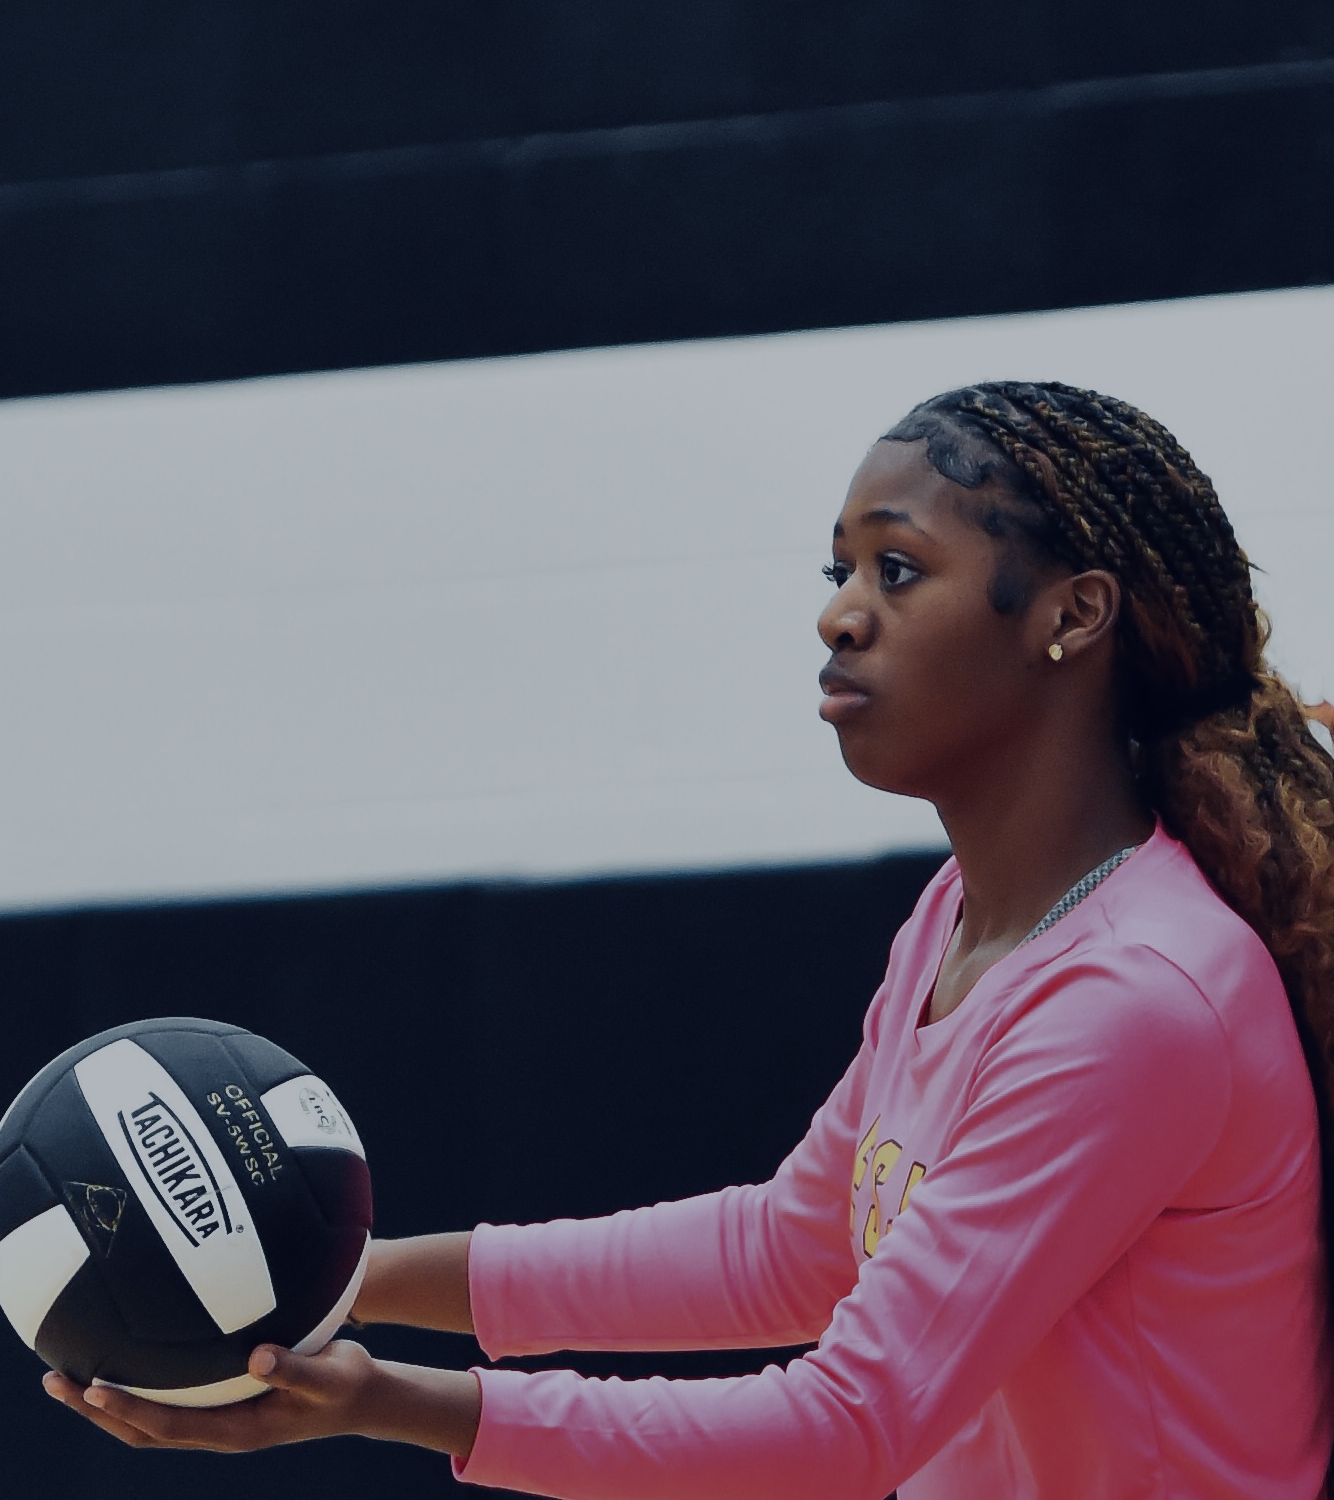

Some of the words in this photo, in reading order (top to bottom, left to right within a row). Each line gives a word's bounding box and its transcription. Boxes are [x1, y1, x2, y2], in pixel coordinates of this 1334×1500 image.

[130, 1090, 220, 1240] TACHIKARA
[206, 1092, 265, 1186] SV-5WSC
[224, 1084, 283, 1181] OFFICIAL
